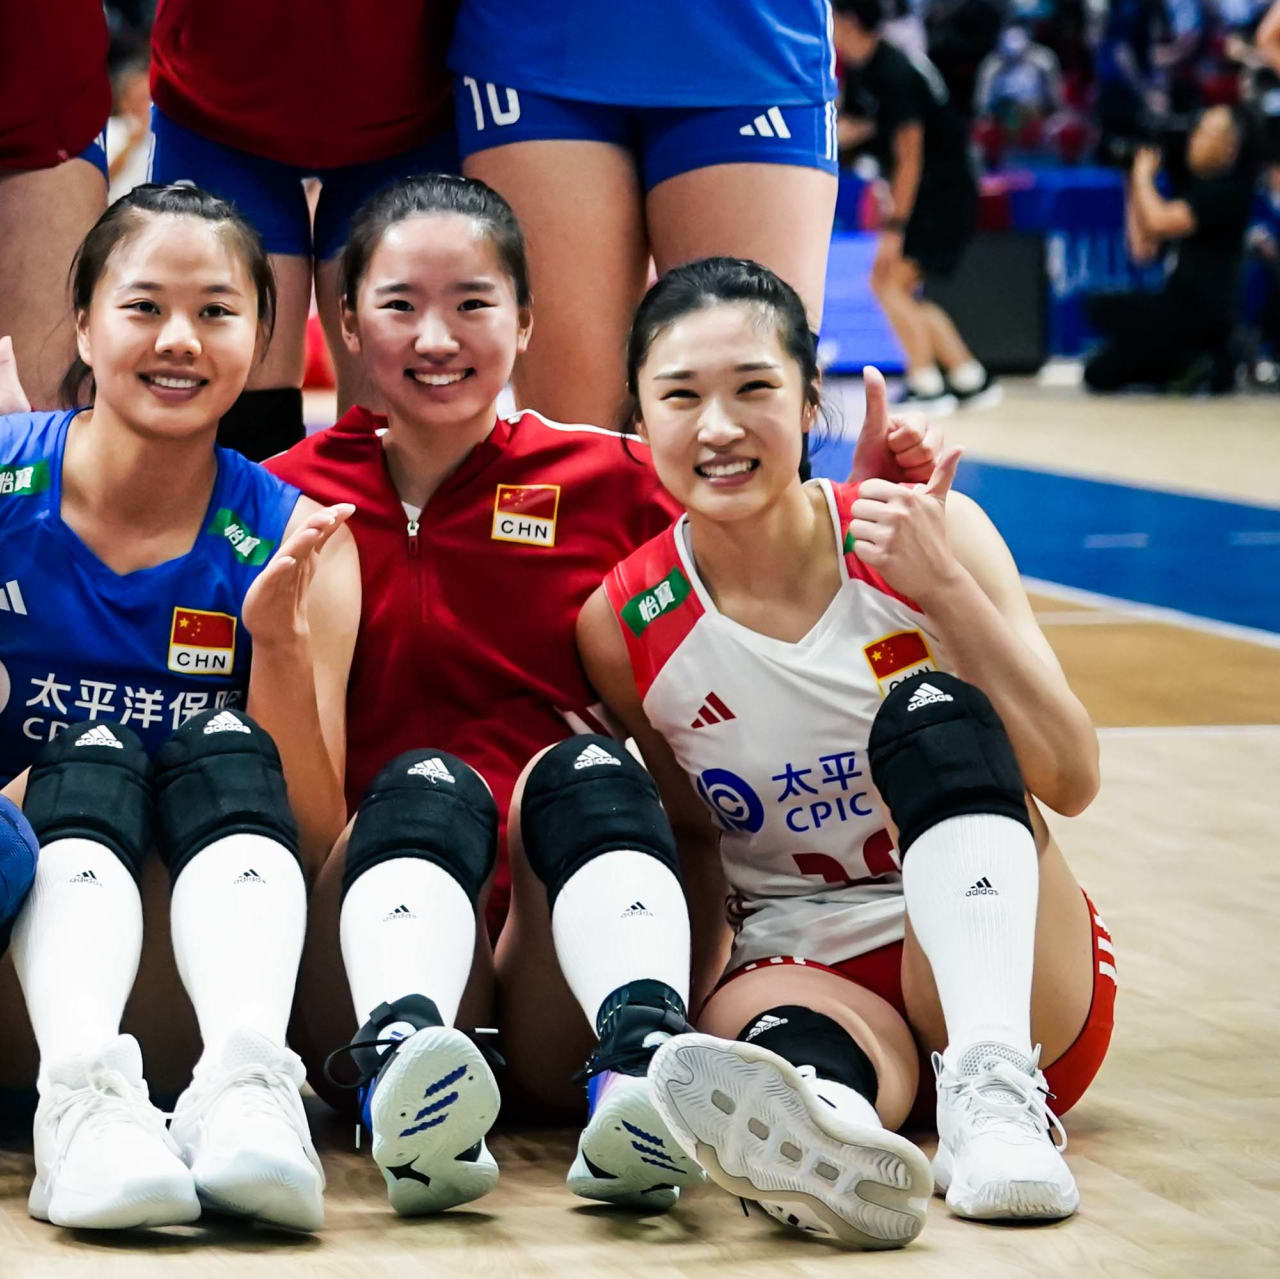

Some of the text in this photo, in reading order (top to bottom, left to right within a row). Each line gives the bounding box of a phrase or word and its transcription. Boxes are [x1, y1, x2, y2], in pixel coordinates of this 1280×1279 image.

[463, 75, 521, 131] 10
[501, 520, 548, 539] CHN
[176, 652, 226, 669] CHN
[907, 693, 954, 711] adidas
[573, 756, 622, 770] adidas
[785, 791, 874, 834] CPIC
